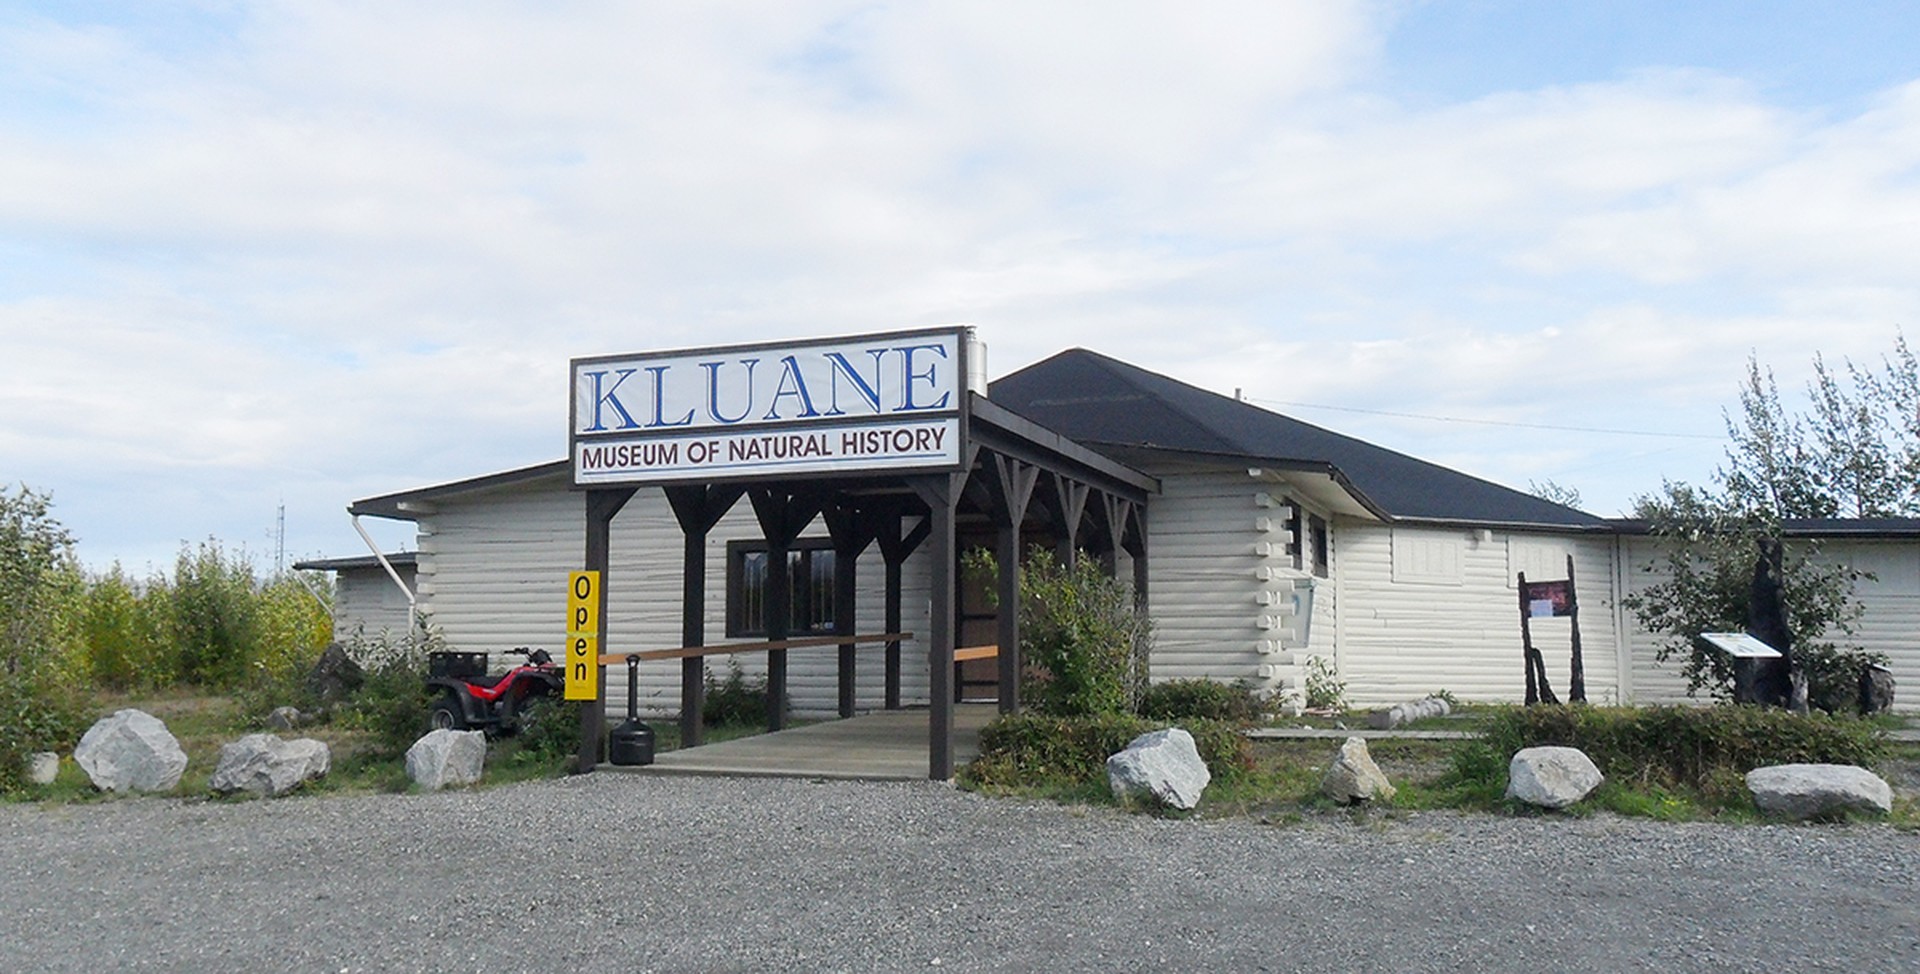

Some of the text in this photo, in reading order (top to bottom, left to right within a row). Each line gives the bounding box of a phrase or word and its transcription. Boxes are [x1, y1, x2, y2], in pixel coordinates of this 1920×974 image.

[583, 343, 951, 432] KLUANE
[582, 427, 947, 469] MUSEUM OF NATURAL HISTORY
[575, 575, 591, 681] Open
